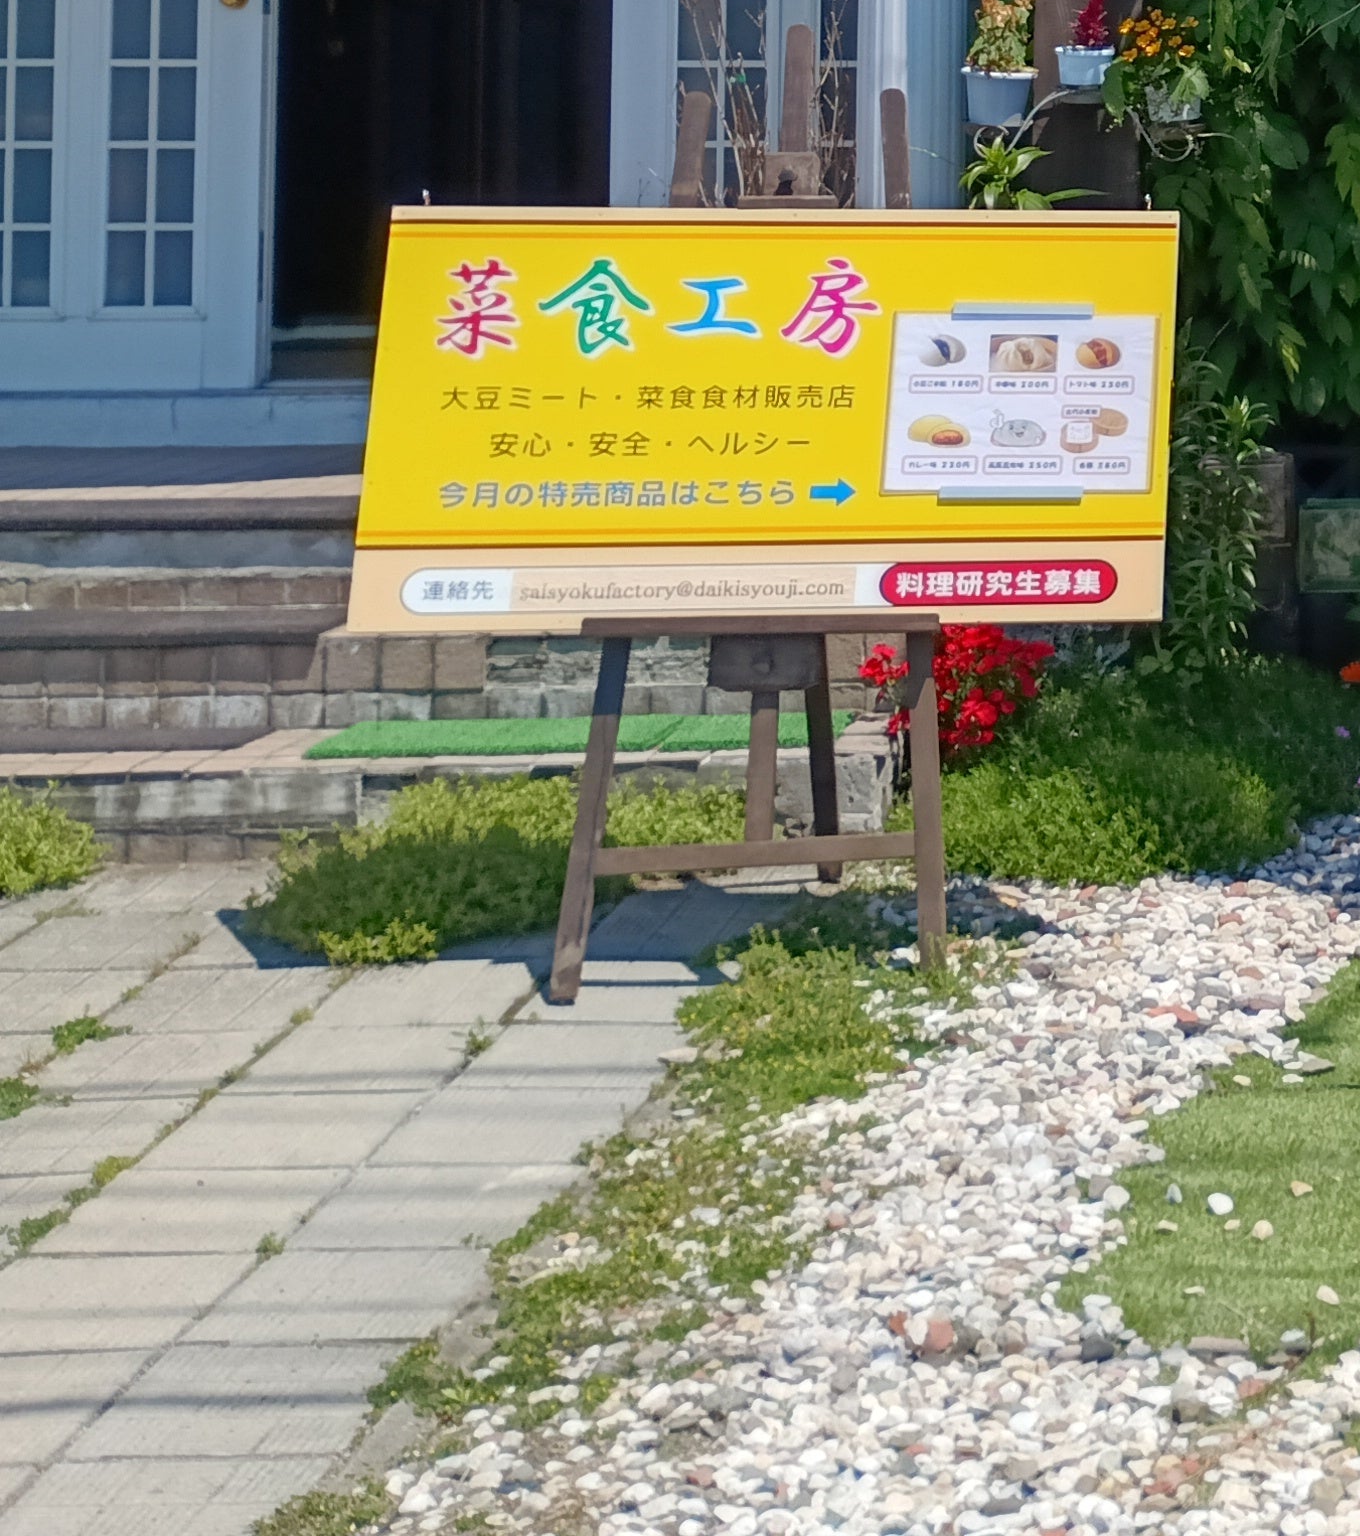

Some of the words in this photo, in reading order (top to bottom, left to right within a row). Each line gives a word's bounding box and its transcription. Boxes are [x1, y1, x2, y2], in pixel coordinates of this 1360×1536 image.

[437, 258, 879, 355] 菜食工房
[440, 384, 856, 410] 大豆ミート・菜食食材販売店
[489, 431, 811, 458] 安心・安全・ヘルシー
[438, 479, 796, 508] 今月の特売商品はこちら
[420, 579, 495, 602] 連絡先
[518, 578, 846, 602] saisyokufactory@daikisyouji.com
[896, 568, 1101, 598] 料理研究生募集
